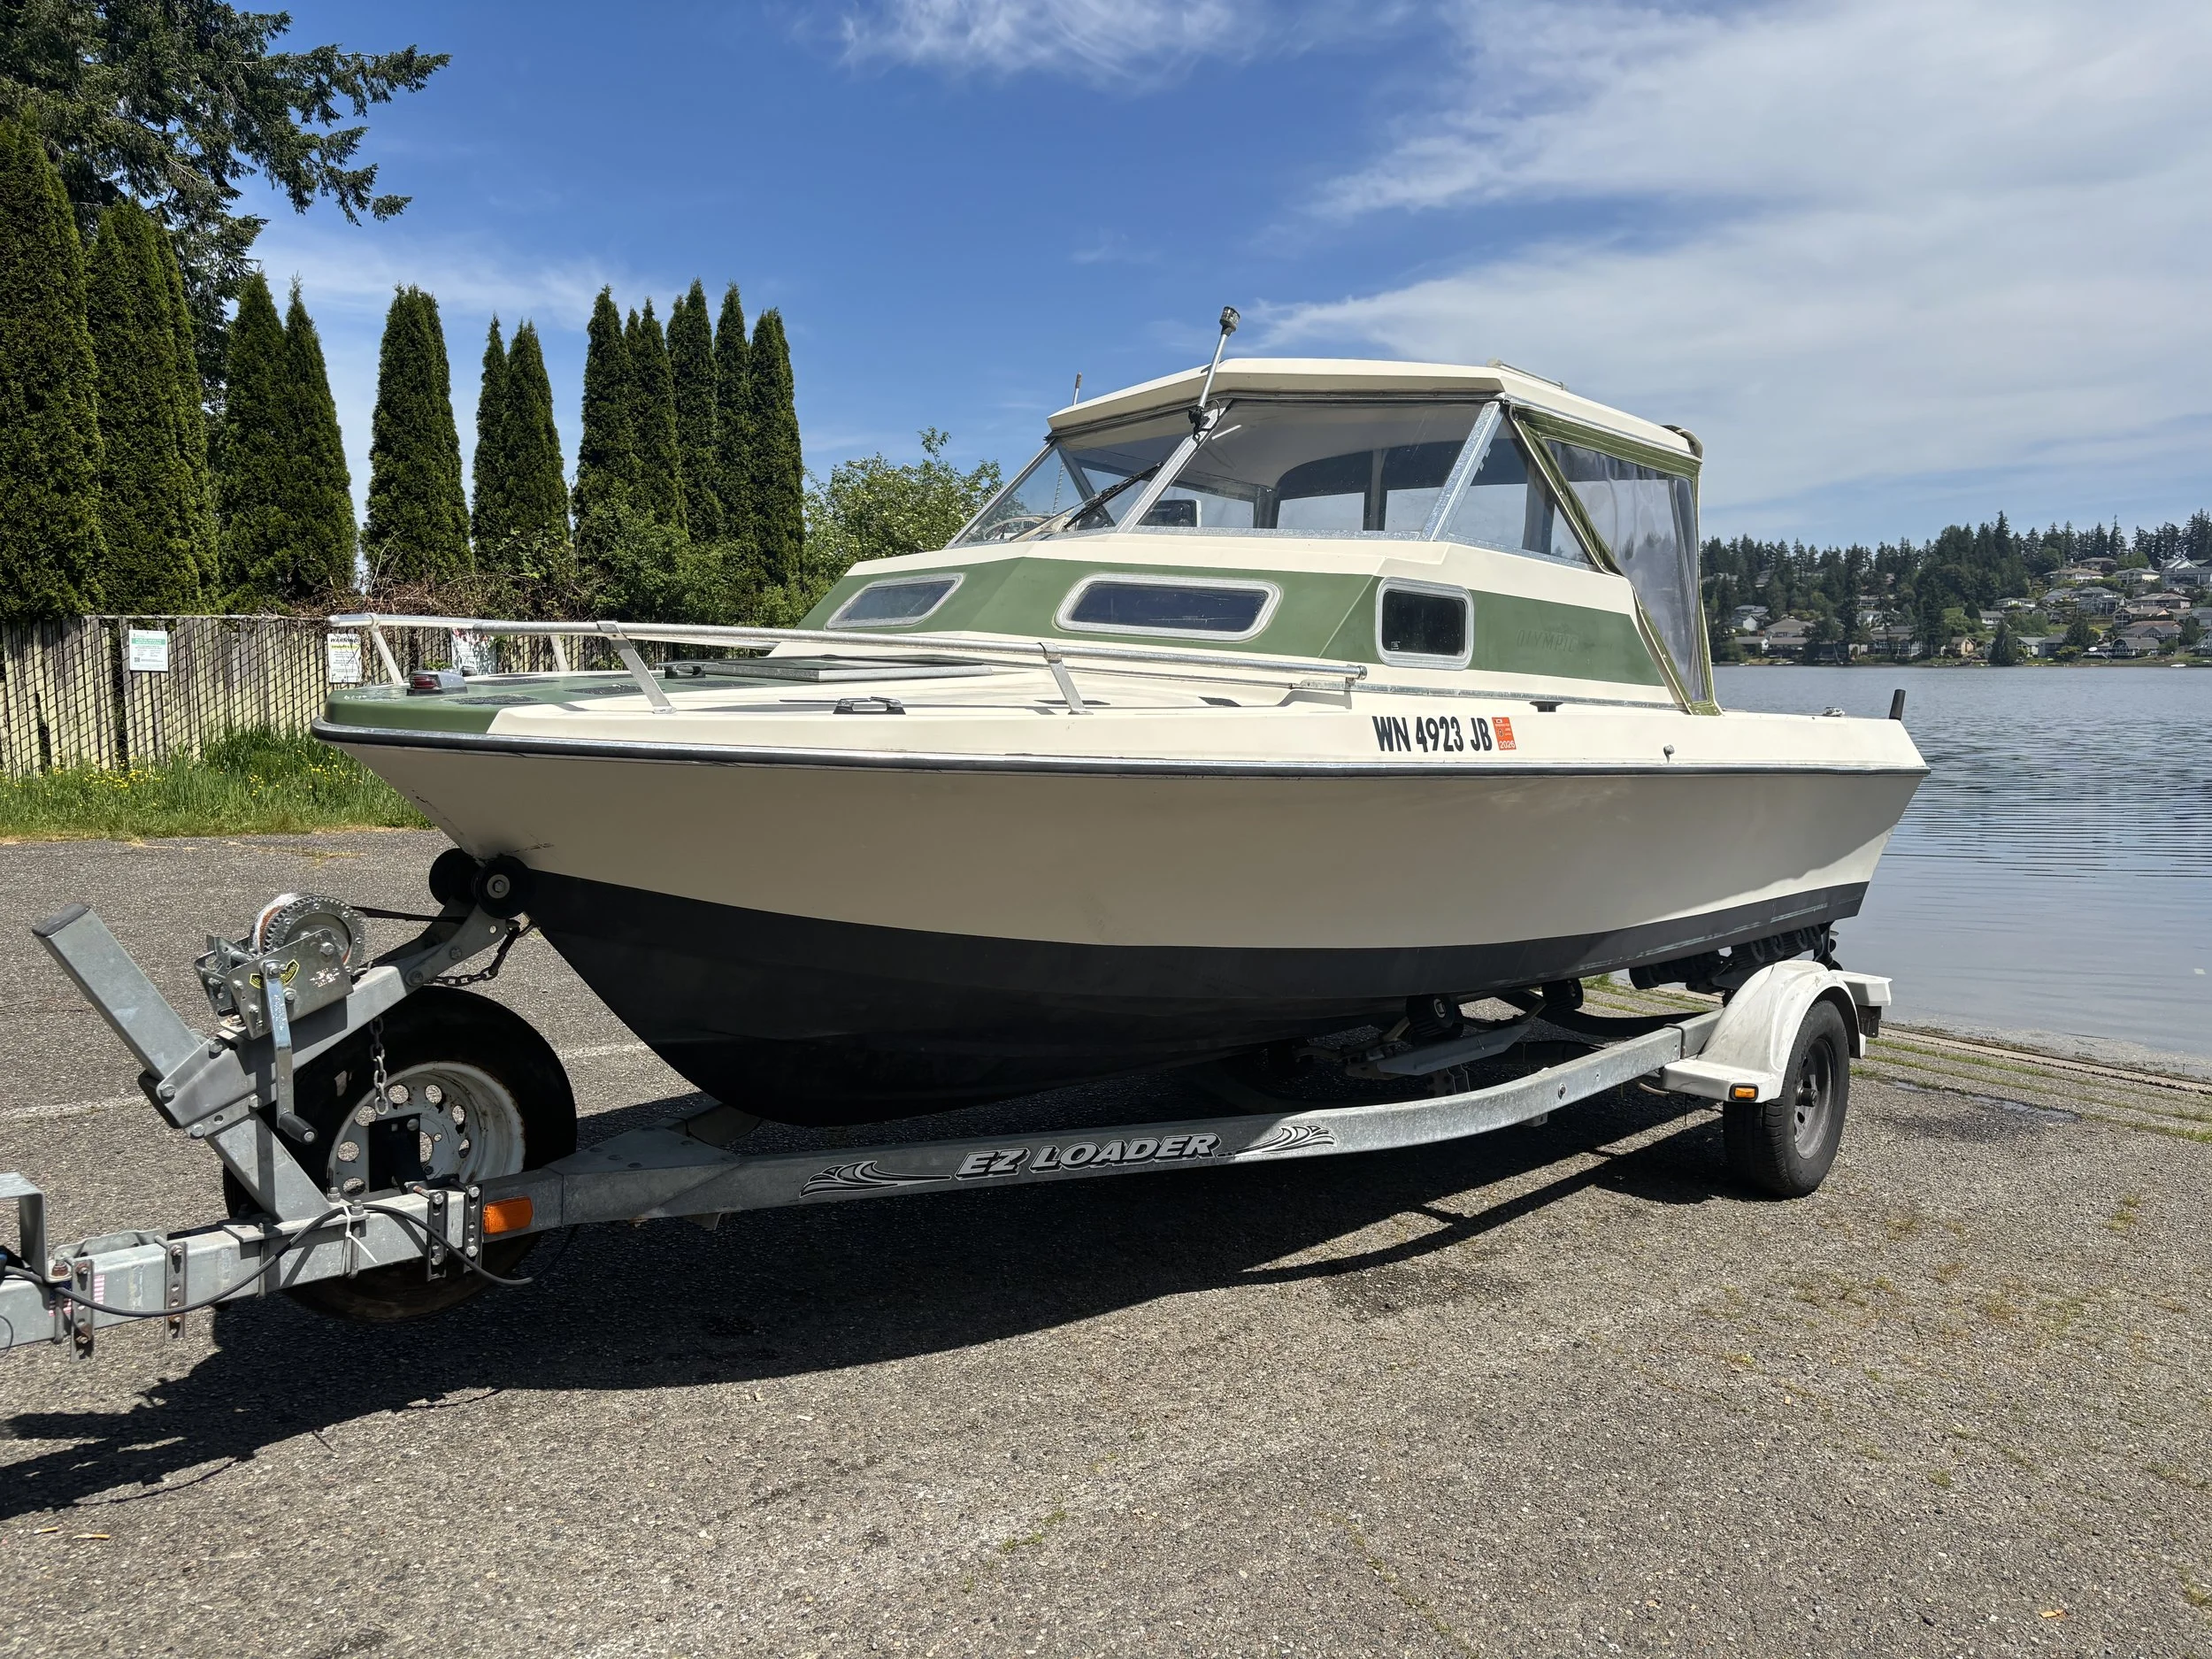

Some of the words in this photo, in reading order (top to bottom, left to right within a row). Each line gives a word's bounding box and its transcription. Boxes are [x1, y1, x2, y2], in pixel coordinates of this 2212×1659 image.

[1516, 629, 1578, 653] OLYMPIC
[1371, 716, 1411, 752] WN
[1416, 716, 1464, 753] 4923
[1471, 717, 1493, 752] JB
[1500, 740, 1516, 749] 2026
[955, 1148, 1031, 1180] EZ
[1029, 1133, 1222, 1174] LOADER
